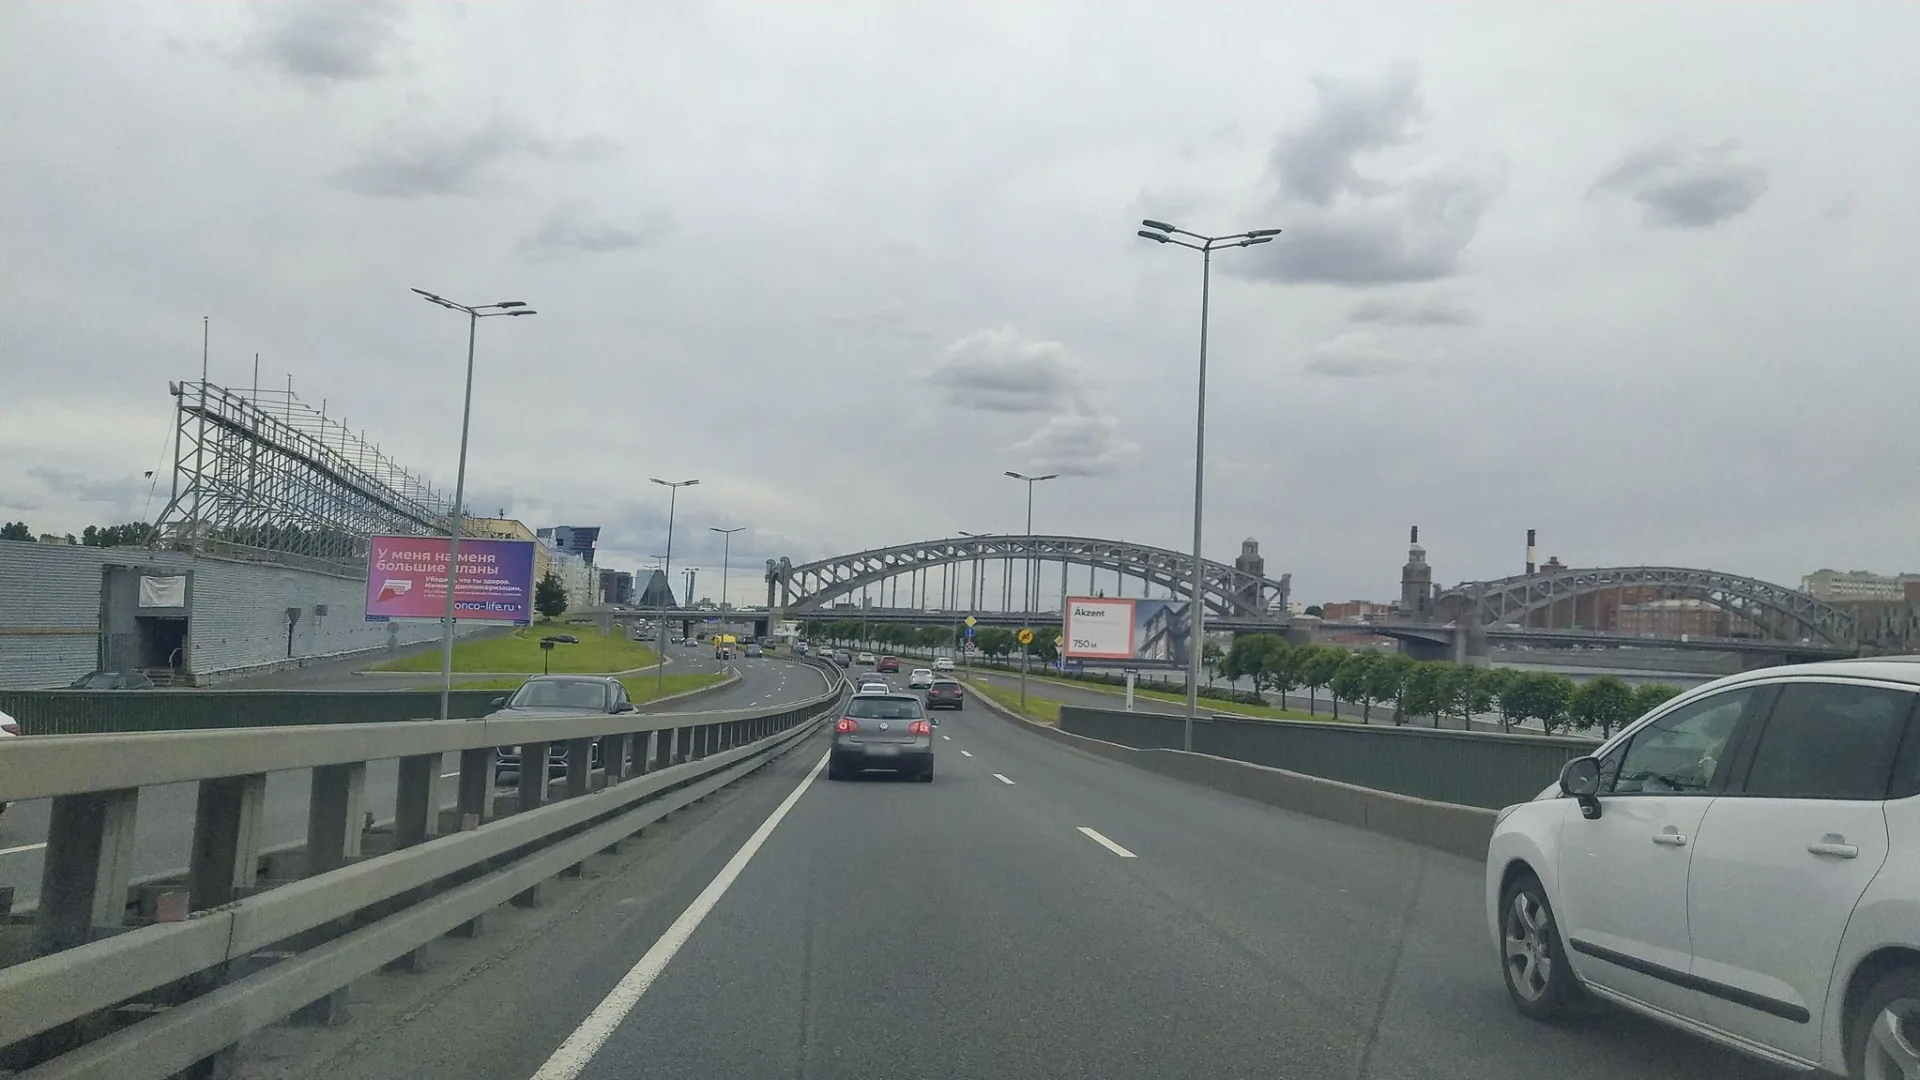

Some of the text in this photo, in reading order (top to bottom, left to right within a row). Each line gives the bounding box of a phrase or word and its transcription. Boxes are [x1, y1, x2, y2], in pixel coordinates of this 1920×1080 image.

[377, 548, 388, 559] У
[391, 551, 431, 561] меня
[456, 553, 496, 563] меня
[376, 559, 446, 573] большие
[455, 601, 515, 612] onco-life.ru
[1073, 639, 1090, 648] 750
